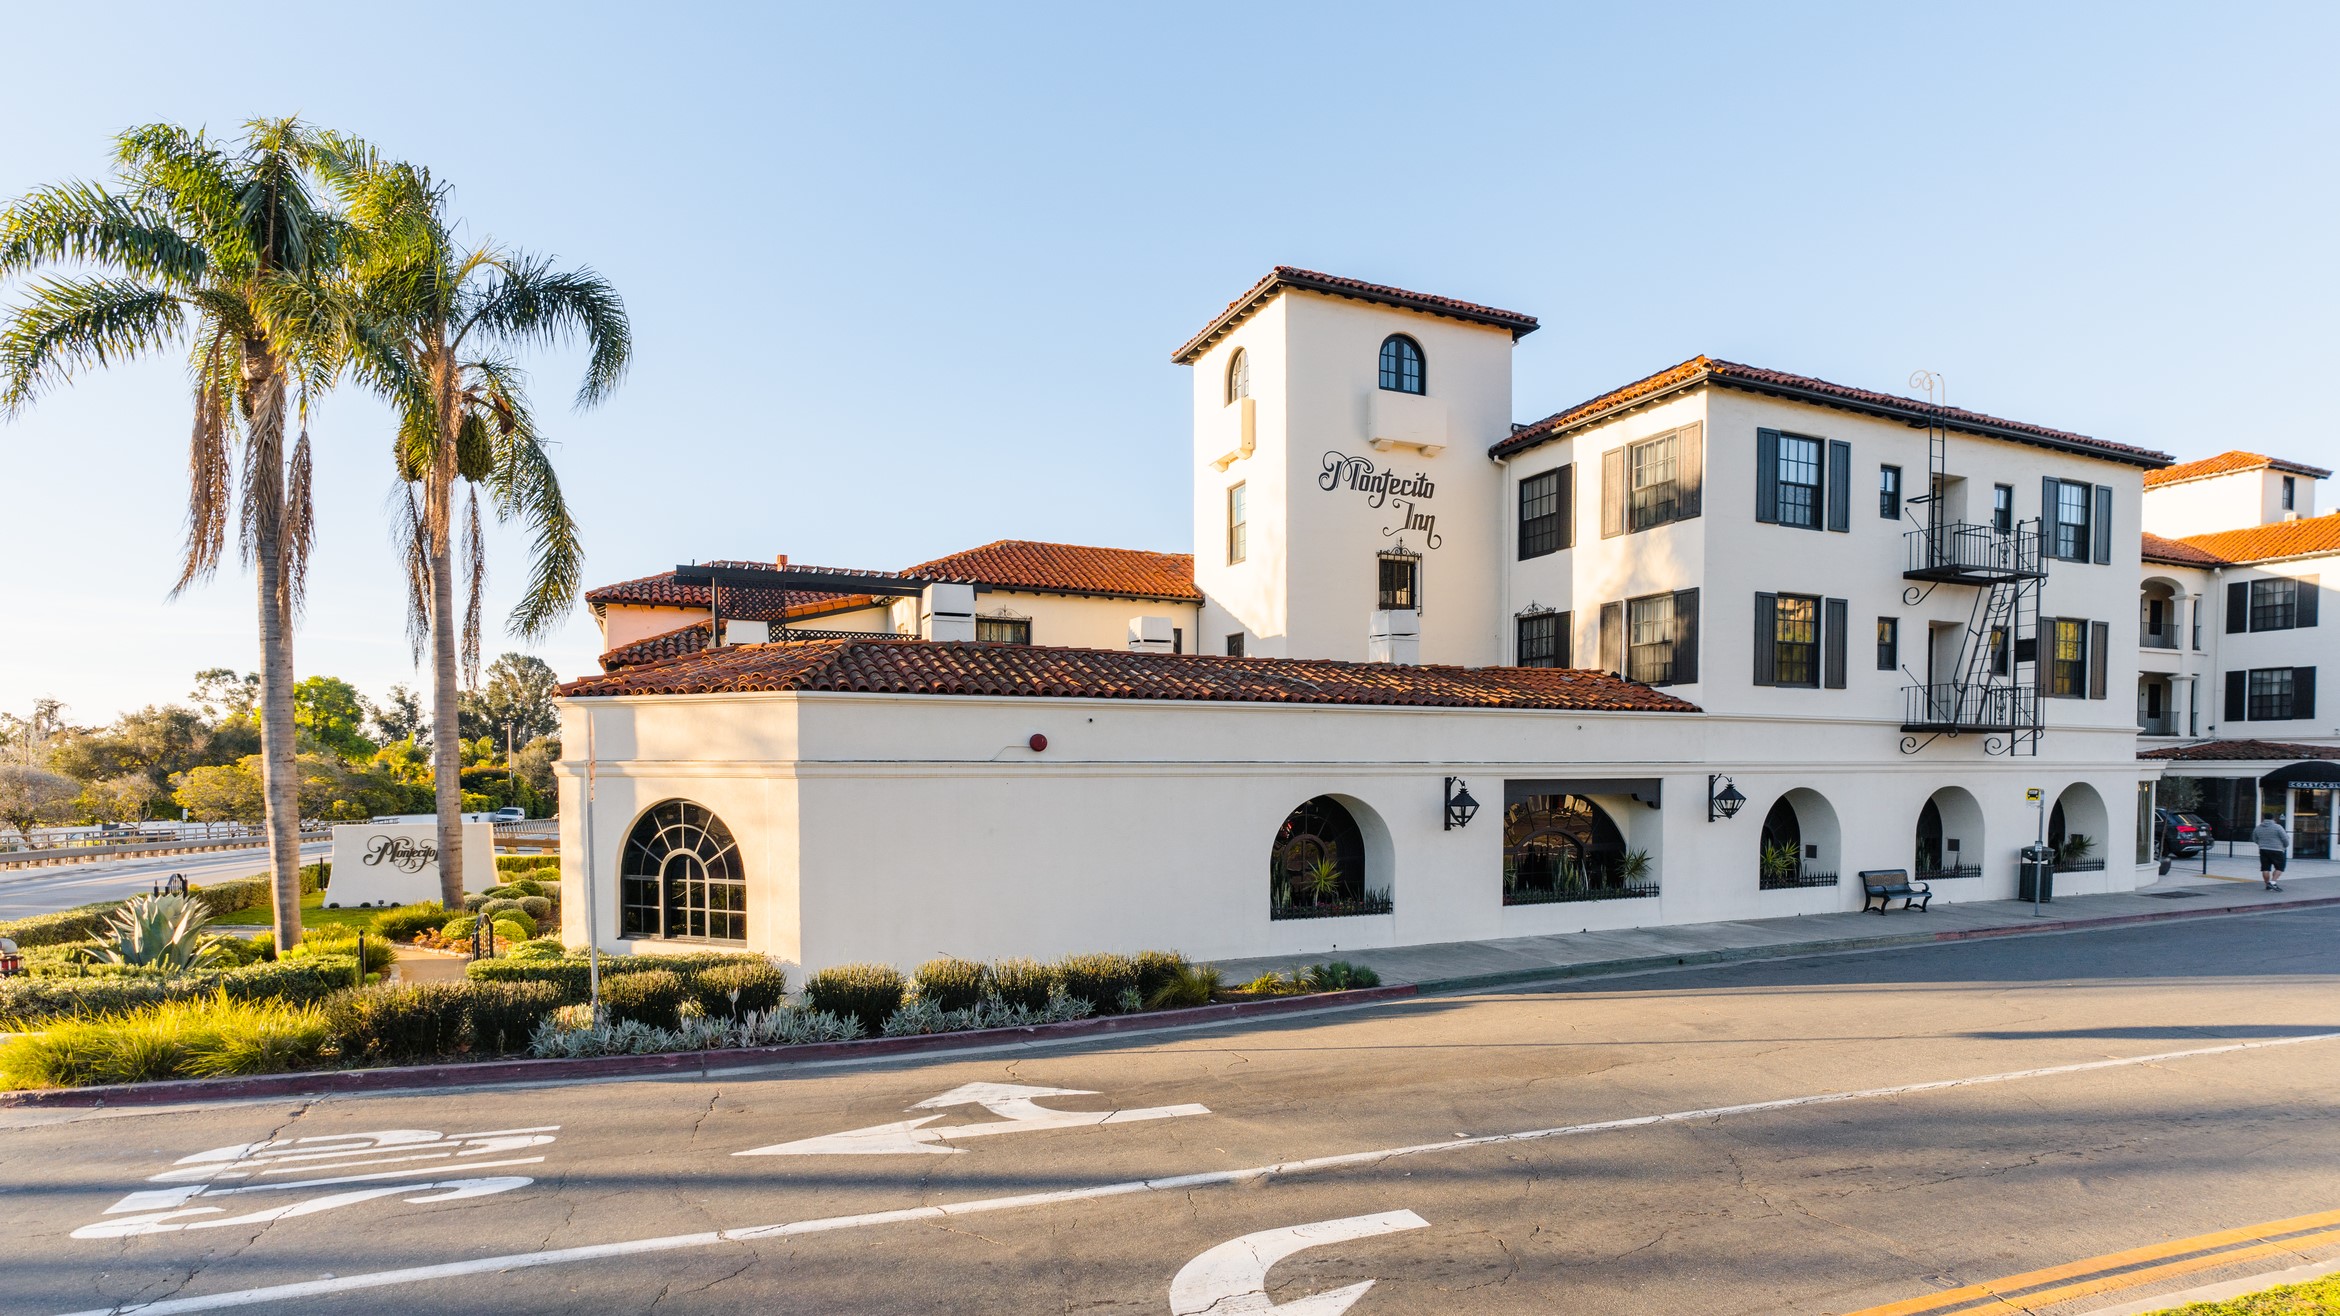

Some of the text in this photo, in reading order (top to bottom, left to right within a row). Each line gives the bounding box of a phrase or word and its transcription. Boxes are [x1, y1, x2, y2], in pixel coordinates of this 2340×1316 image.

[1318, 451, 1435, 508] Montecito
[1382, 498, 1442, 549] Inn
[363, 835, 437, 874] Montecito
[70, 1126, 561, 1239] STOP
